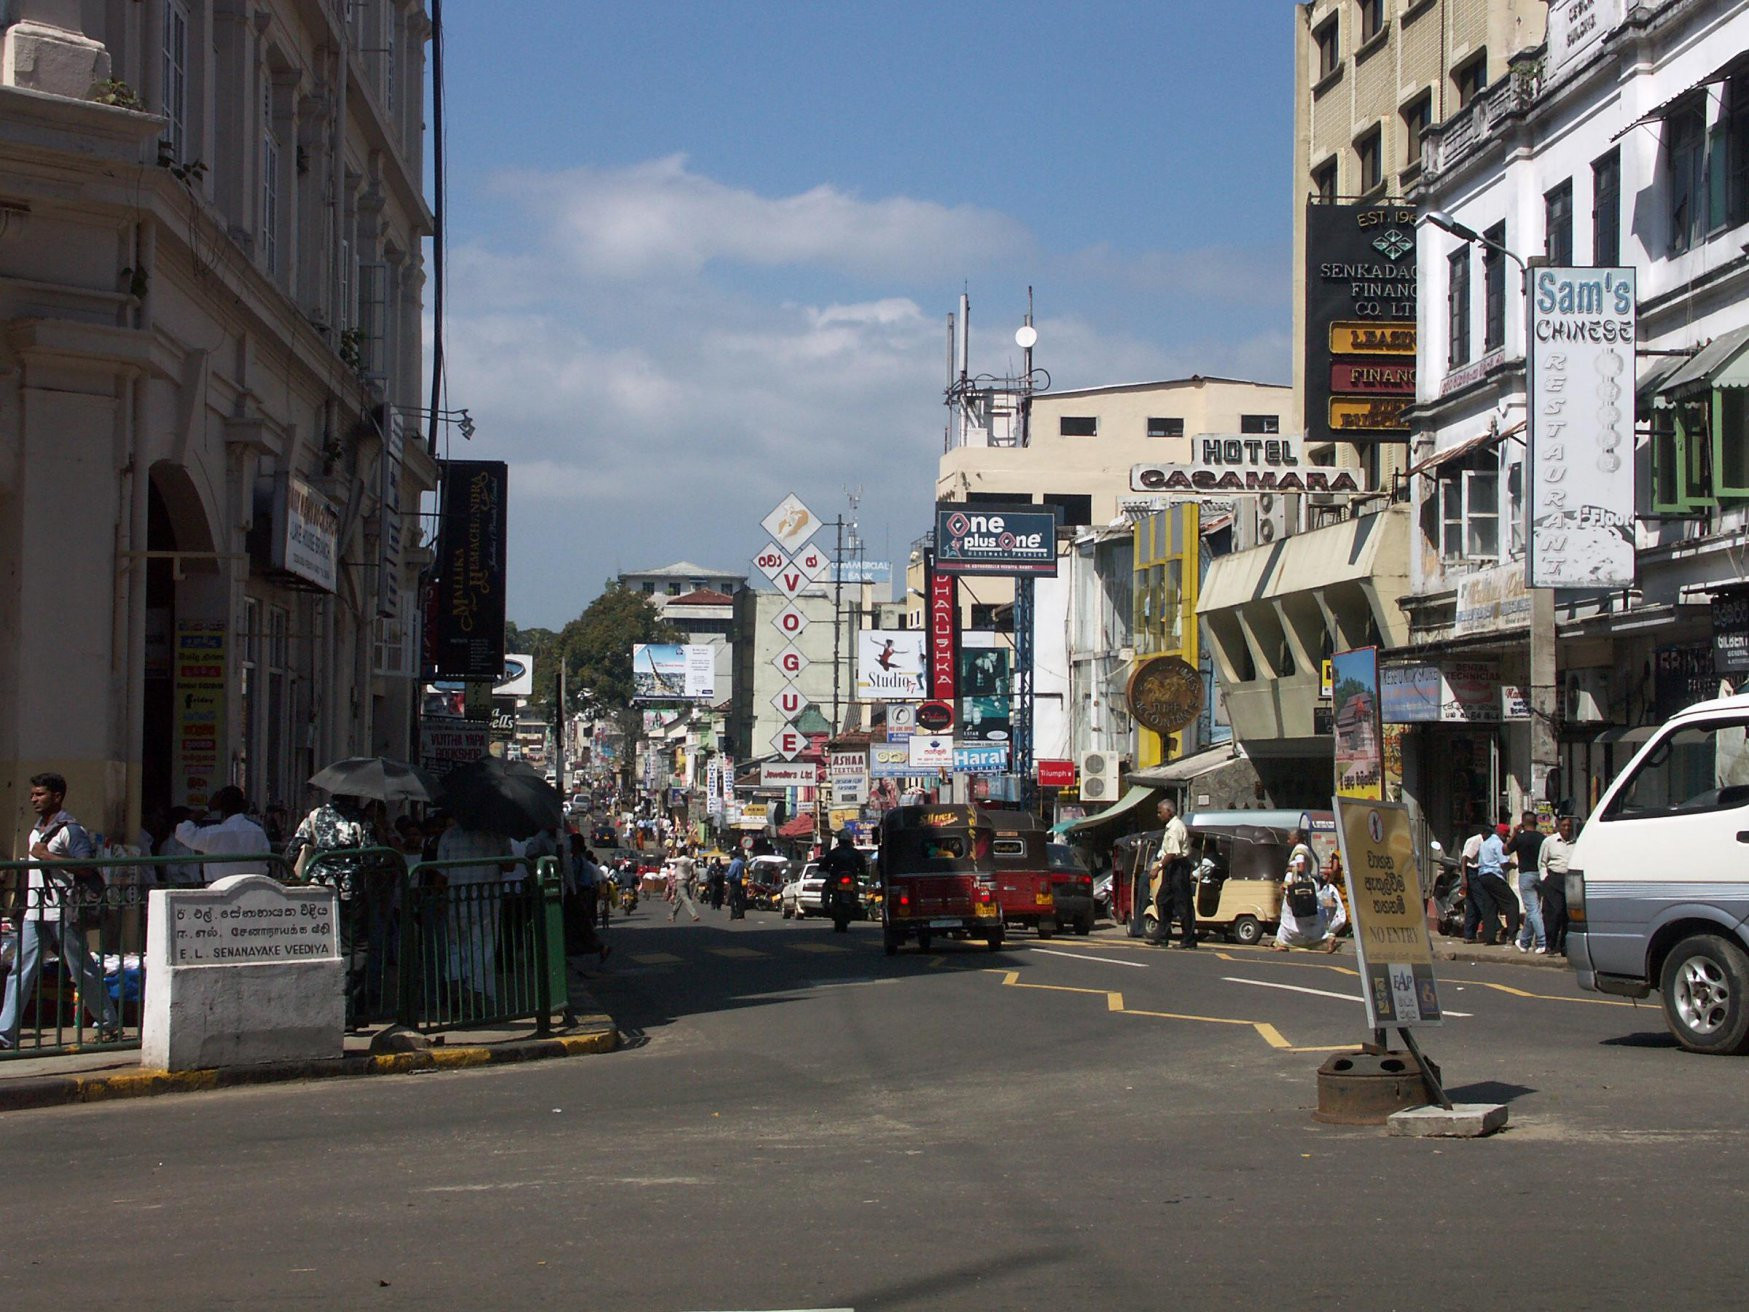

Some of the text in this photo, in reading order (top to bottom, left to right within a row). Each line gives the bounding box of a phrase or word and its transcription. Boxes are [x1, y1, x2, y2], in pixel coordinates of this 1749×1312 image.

[1357, 211, 1417, 228] EST. 196
[1352, 283, 1417, 298] FINANC
[1537, 272, 1632, 315] Sam's
[1355, 302, 1382, 316] CO.
[1351, 330, 1417, 349] LEASIN
[1536, 319, 1633, 344] CHINESE
[1351, 368, 1417, 387] FINANC
[1203, 440, 1298, 466] HOTEL
[1541, 353, 1569, 578] RESTAURANT
[1140, 470, 1359, 491] CASAMARA
[946, 512, 1005, 538] One
[1592, 508, 1634, 528] Floor
[964, 532, 1041, 551] plus One
[831, 561, 890, 570] CMMERCIAL
[452, 548, 478, 632] MALLIKA
[782, 574, 800, 752] VOGUE
[868, 672, 909, 688] Studio
[436, 748, 482, 760] BOOKSHOP
[833, 755, 864, 766] ASHAA
[954, 748, 1006, 766] Haral
[764, 770, 798, 780] Jewellers
[1040, 770, 1067, 778] Triumph
[1369, 926, 1419, 944] NO ENTRY
[213, 944, 280, 958] SENANAYAKE
[284, 943, 329, 955] VEEDIYA
[1393, 969, 1412, 991] EAP
